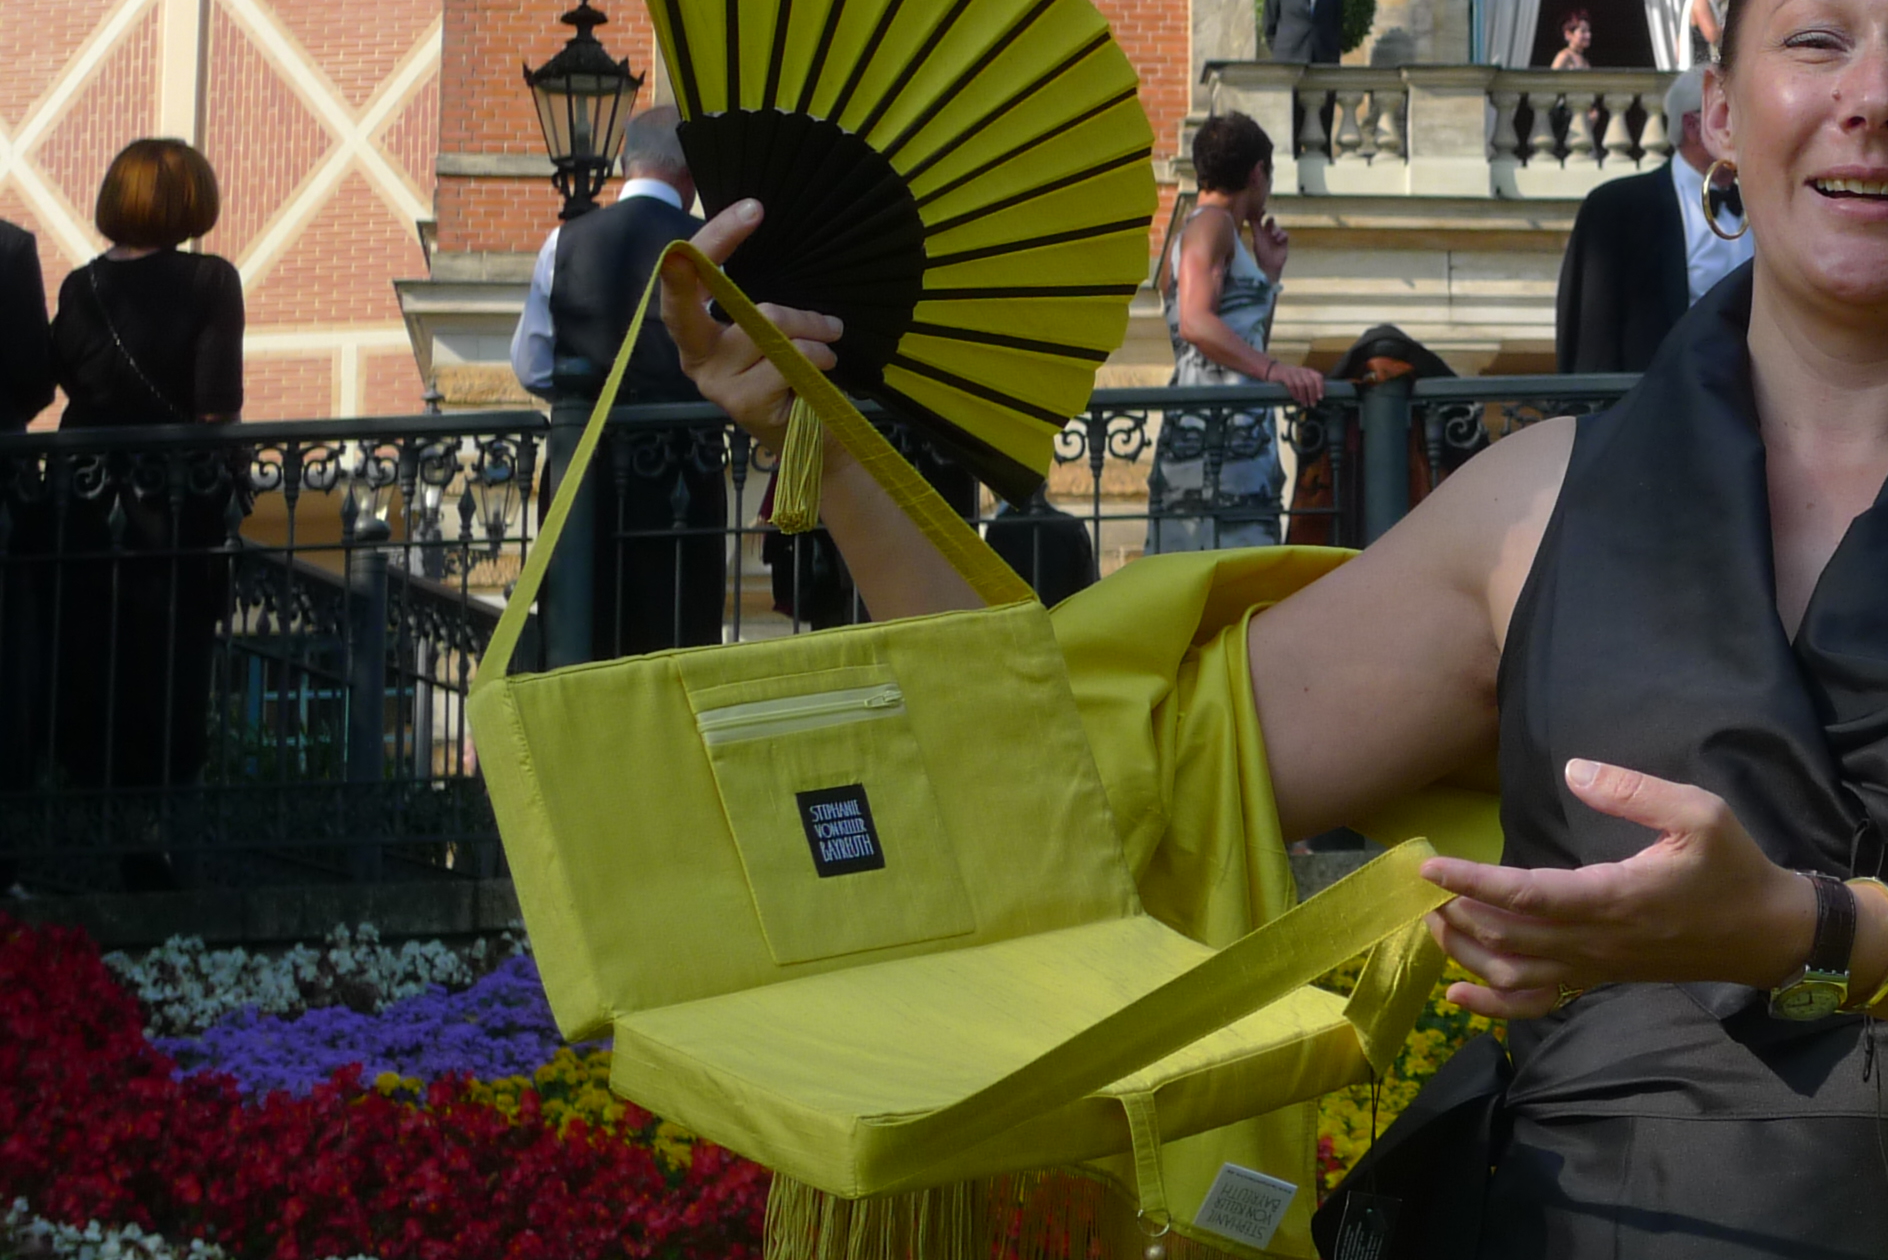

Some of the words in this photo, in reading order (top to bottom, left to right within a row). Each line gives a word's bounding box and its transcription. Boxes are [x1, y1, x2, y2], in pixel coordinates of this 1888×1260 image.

[810, 799, 862, 822] STEPHANIE
[814, 821, 839, 838] VON
[838, 818, 867, 835] KELLER
[820, 834, 874, 862] BAYREUTH
[1214, 1197, 1246, 1215] KELLER
[1220, 1182, 1281, 1212] BAYREUTH
[1206, 1209, 1266, 1239] STEPHANIE
